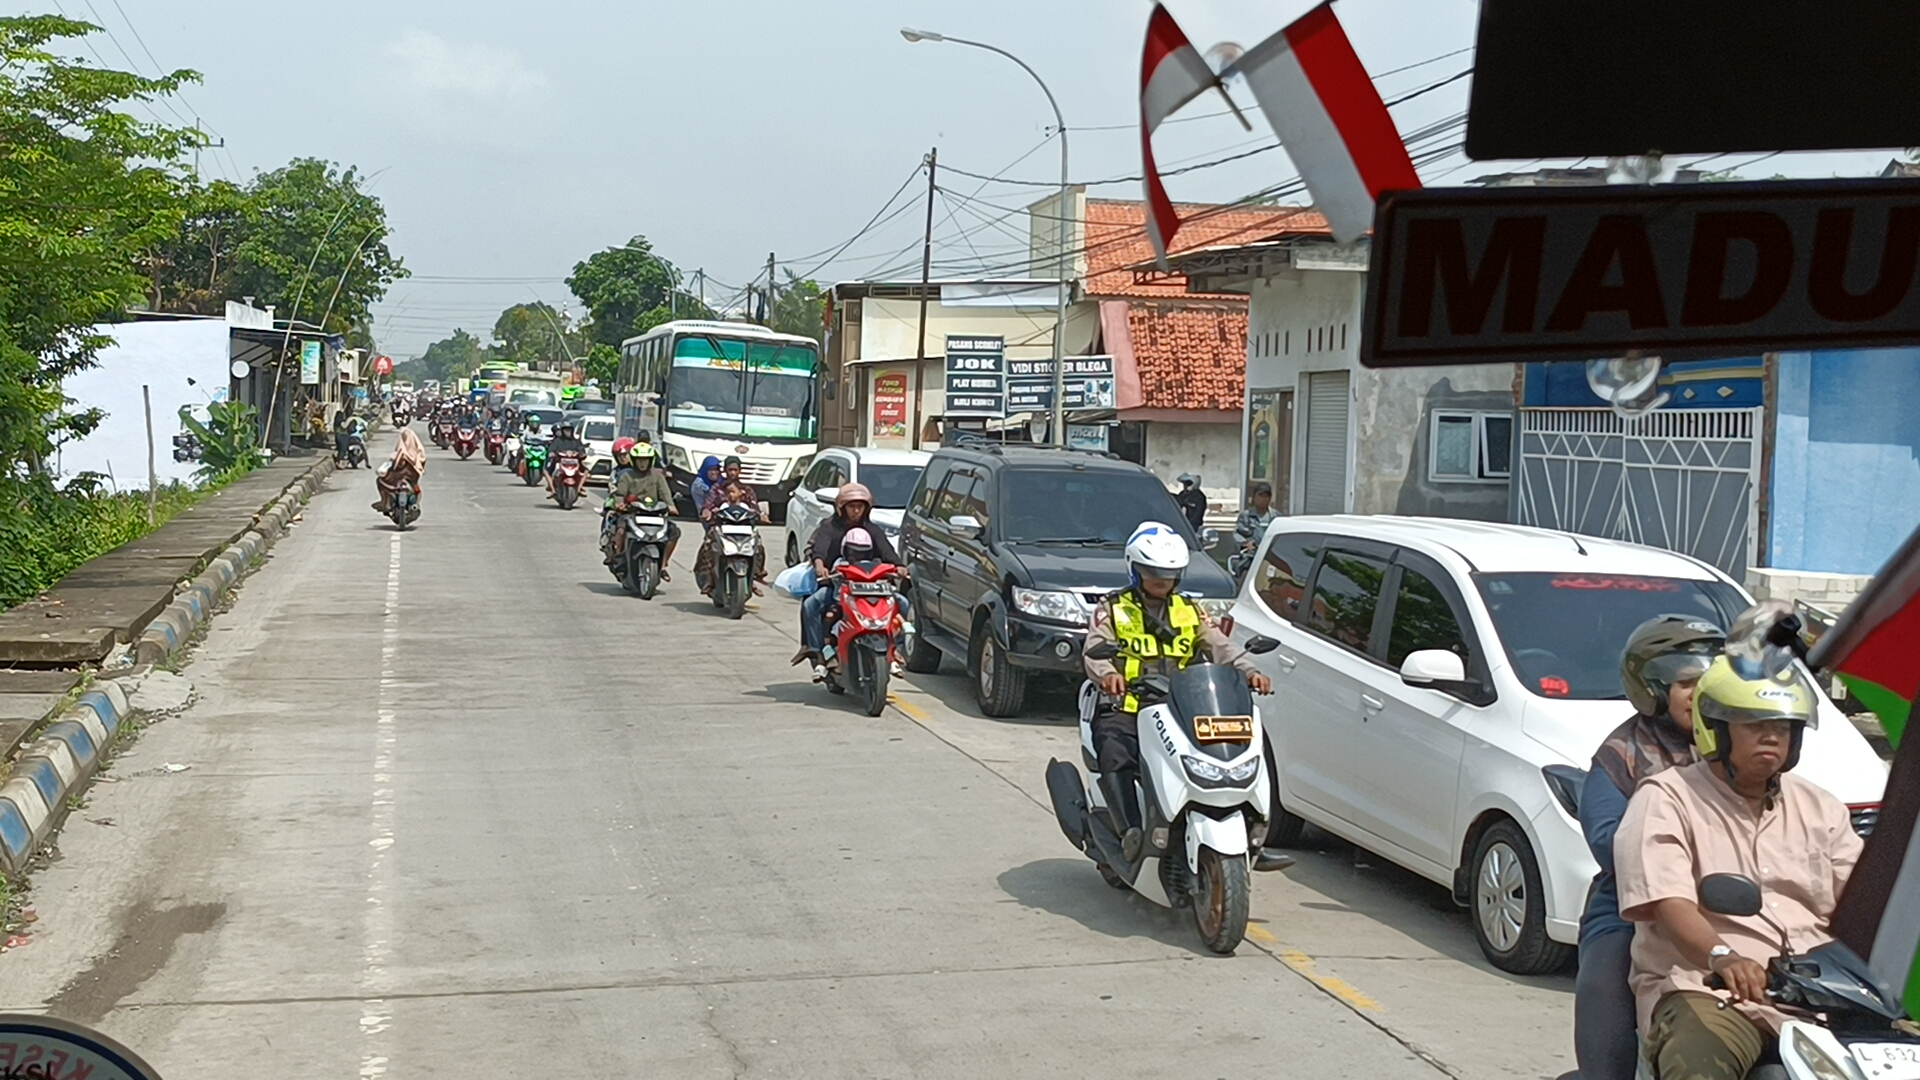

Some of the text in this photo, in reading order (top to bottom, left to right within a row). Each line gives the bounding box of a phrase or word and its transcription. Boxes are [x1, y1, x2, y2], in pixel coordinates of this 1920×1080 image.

[954, 358, 996, 369] JOK
[1011, 361, 1108, 373] VIDI STICER BLEGA
[953, 379, 970, 388] PLAT
[1152, 710, 1177, 757] POLISI
